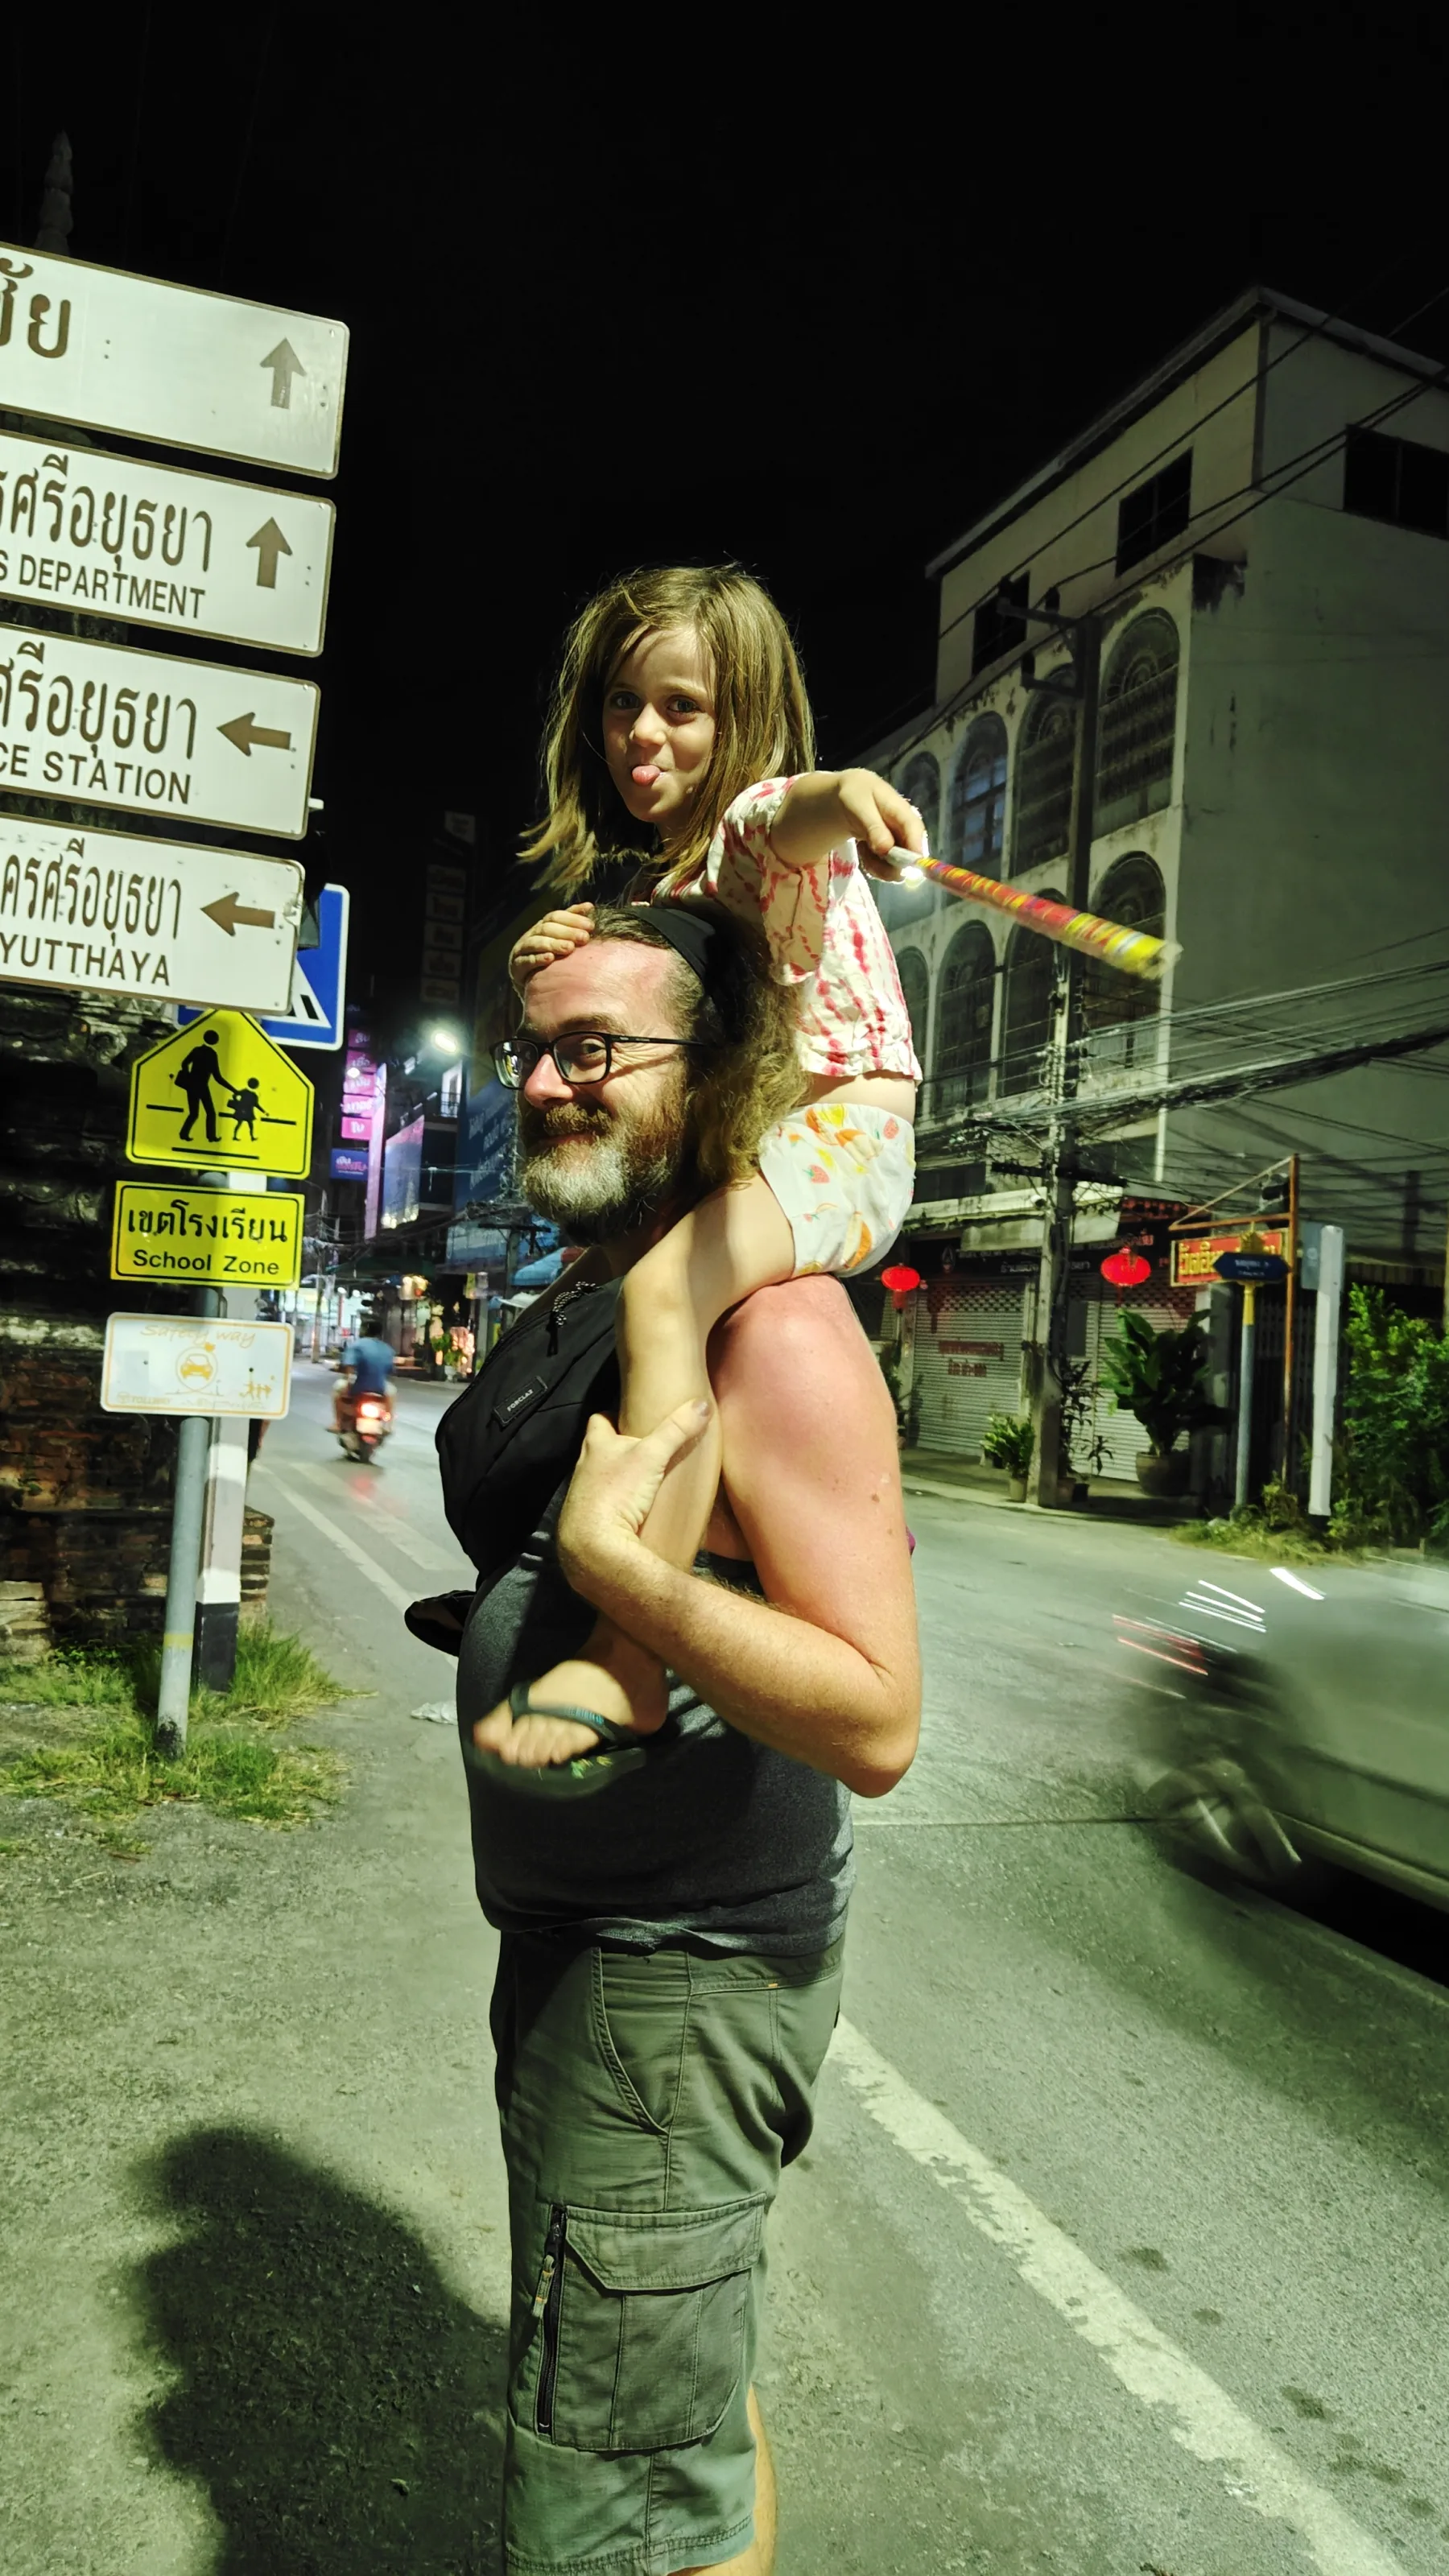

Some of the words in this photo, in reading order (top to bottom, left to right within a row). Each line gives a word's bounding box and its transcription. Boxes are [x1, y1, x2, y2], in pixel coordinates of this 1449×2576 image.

[19, 553, 206, 620] DEPARTMENT
[43, 750, 192, 805] STATION
[0, 931, 170, 987] YUTTHAYA
[127, 1199, 288, 1243] เขตโรงเรียน
[132, 1249, 212, 1272] School
[222, 1255, 280, 1275] Zone
[216, 1331, 257, 1349] way
[506, 1389, 534, 1412] FORCLAZ
